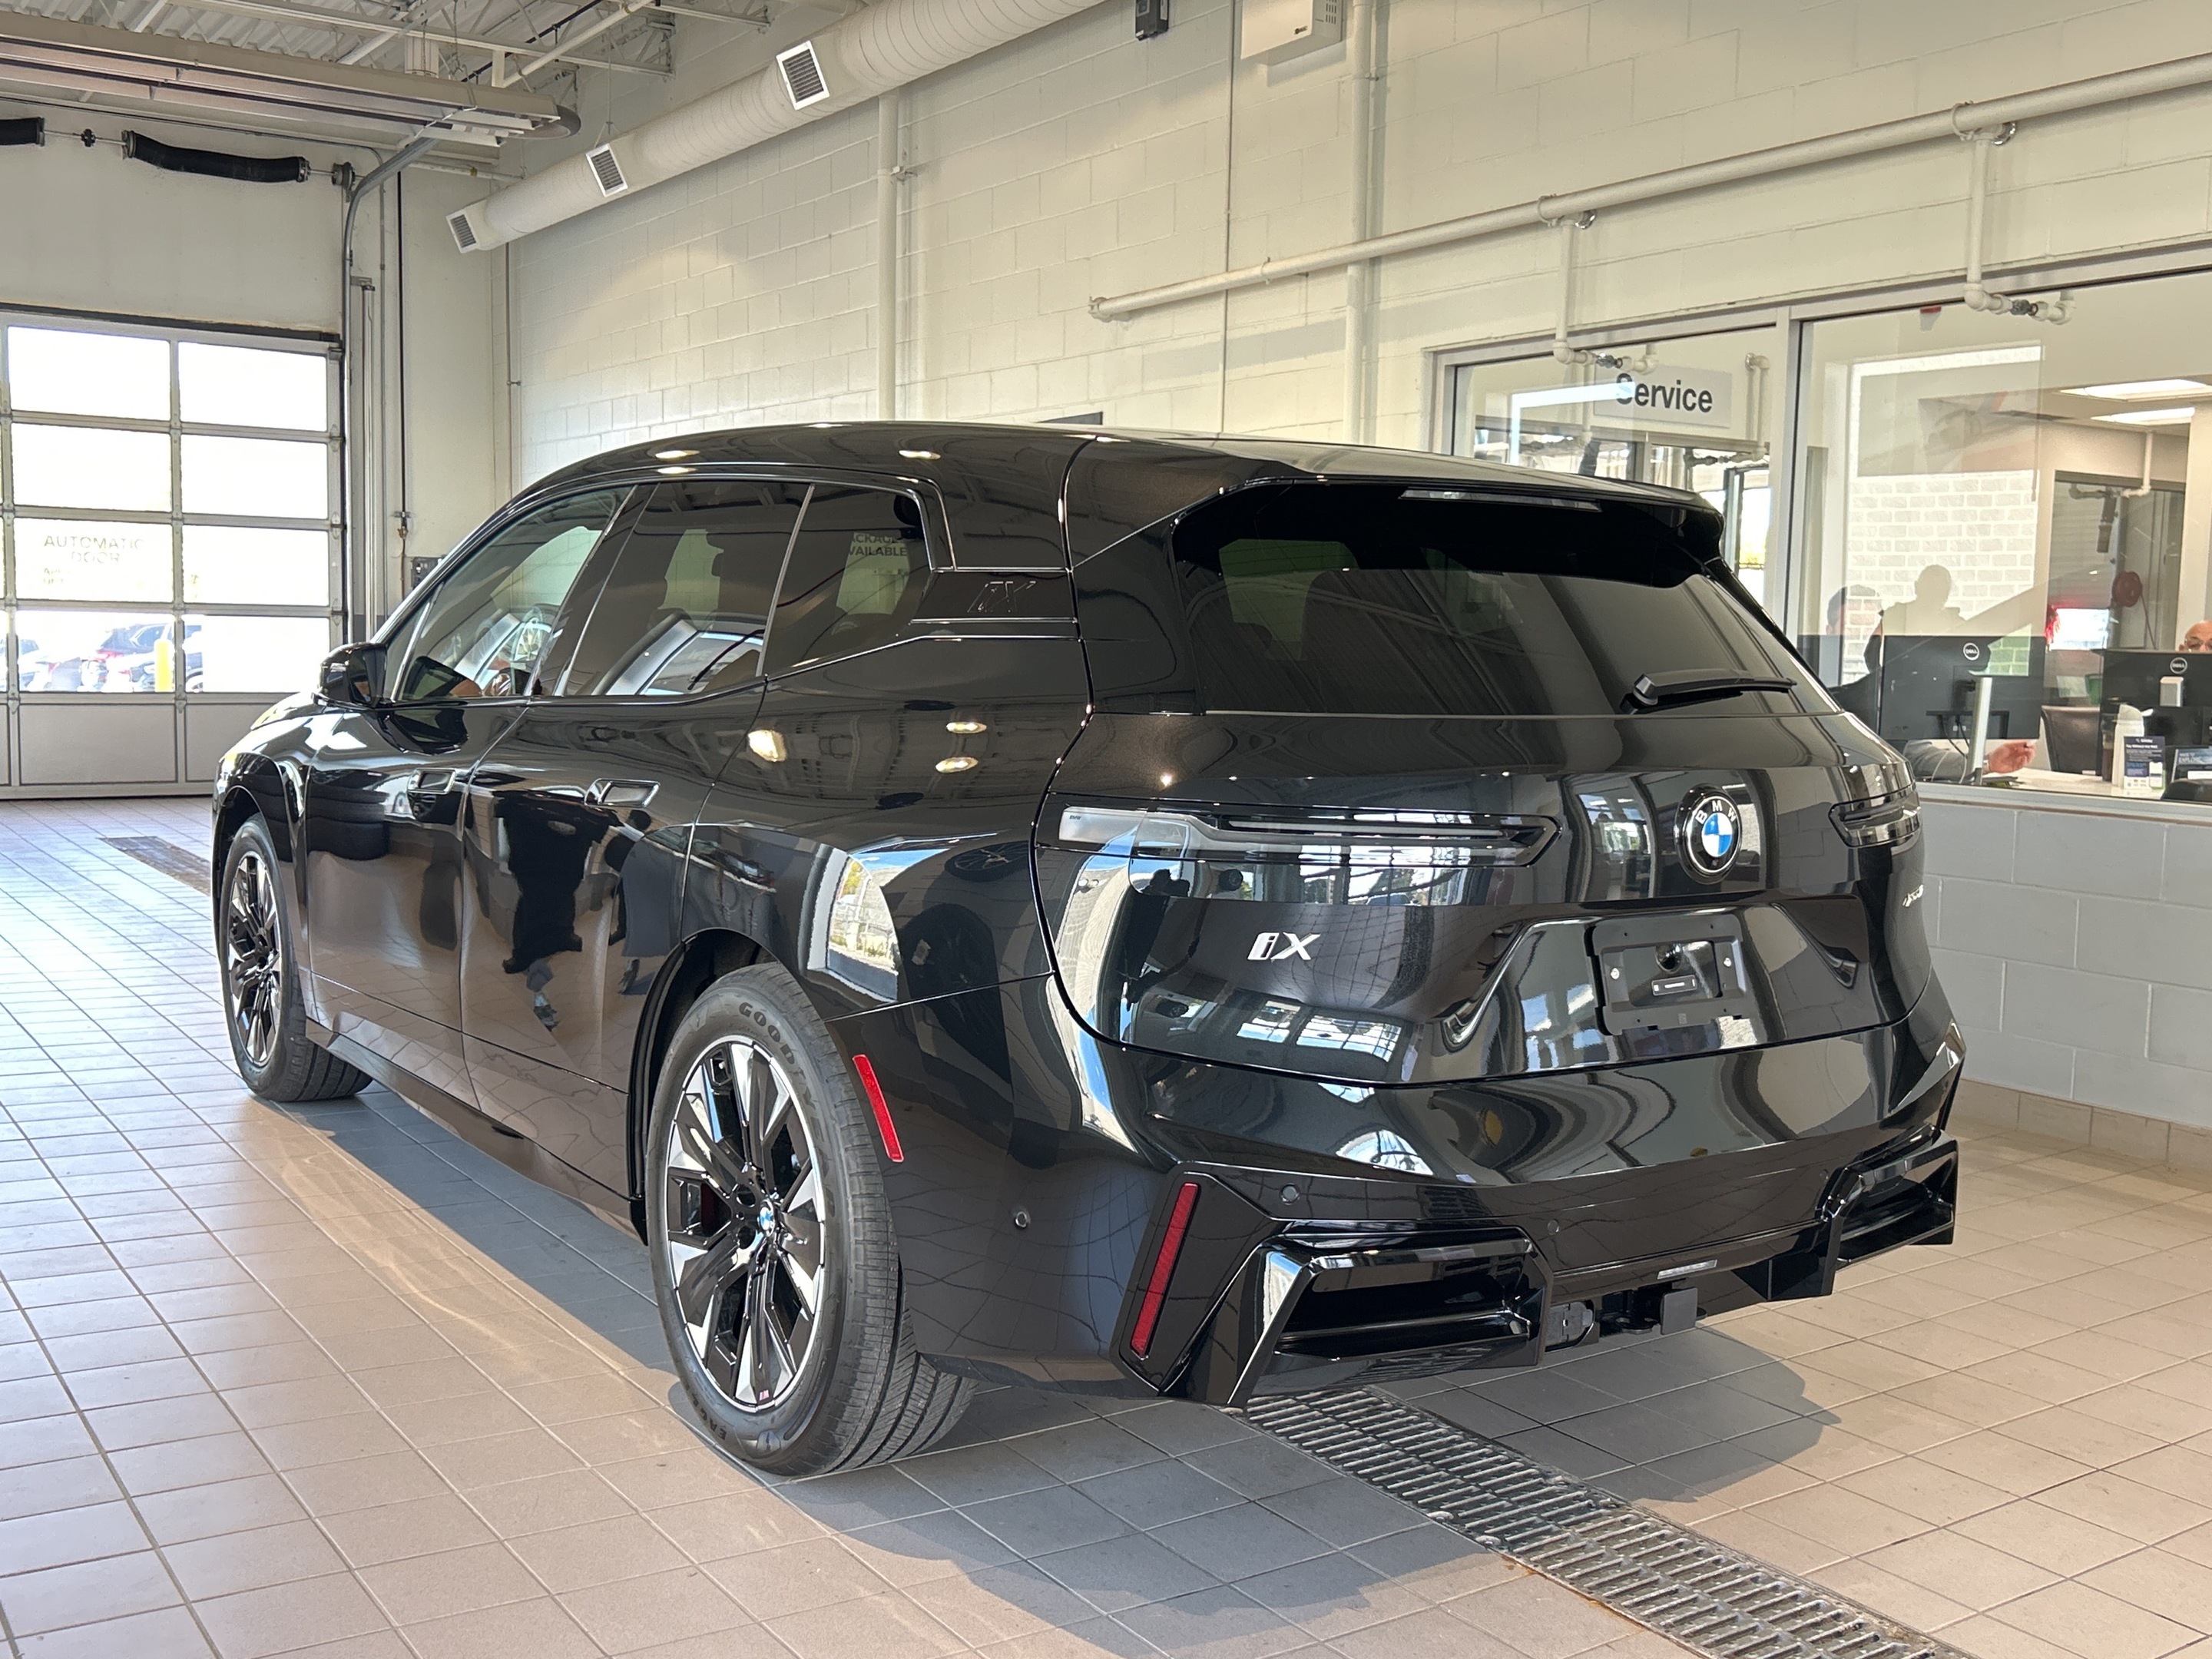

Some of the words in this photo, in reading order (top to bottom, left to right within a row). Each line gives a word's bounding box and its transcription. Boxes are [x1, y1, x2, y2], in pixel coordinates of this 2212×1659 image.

[44, 536, 144, 549] AUTOMATIC
[71, 551, 121, 564] DOOR
[1695, 800, 1737, 824] BMW
[1247, 932, 1321, 961] iX
